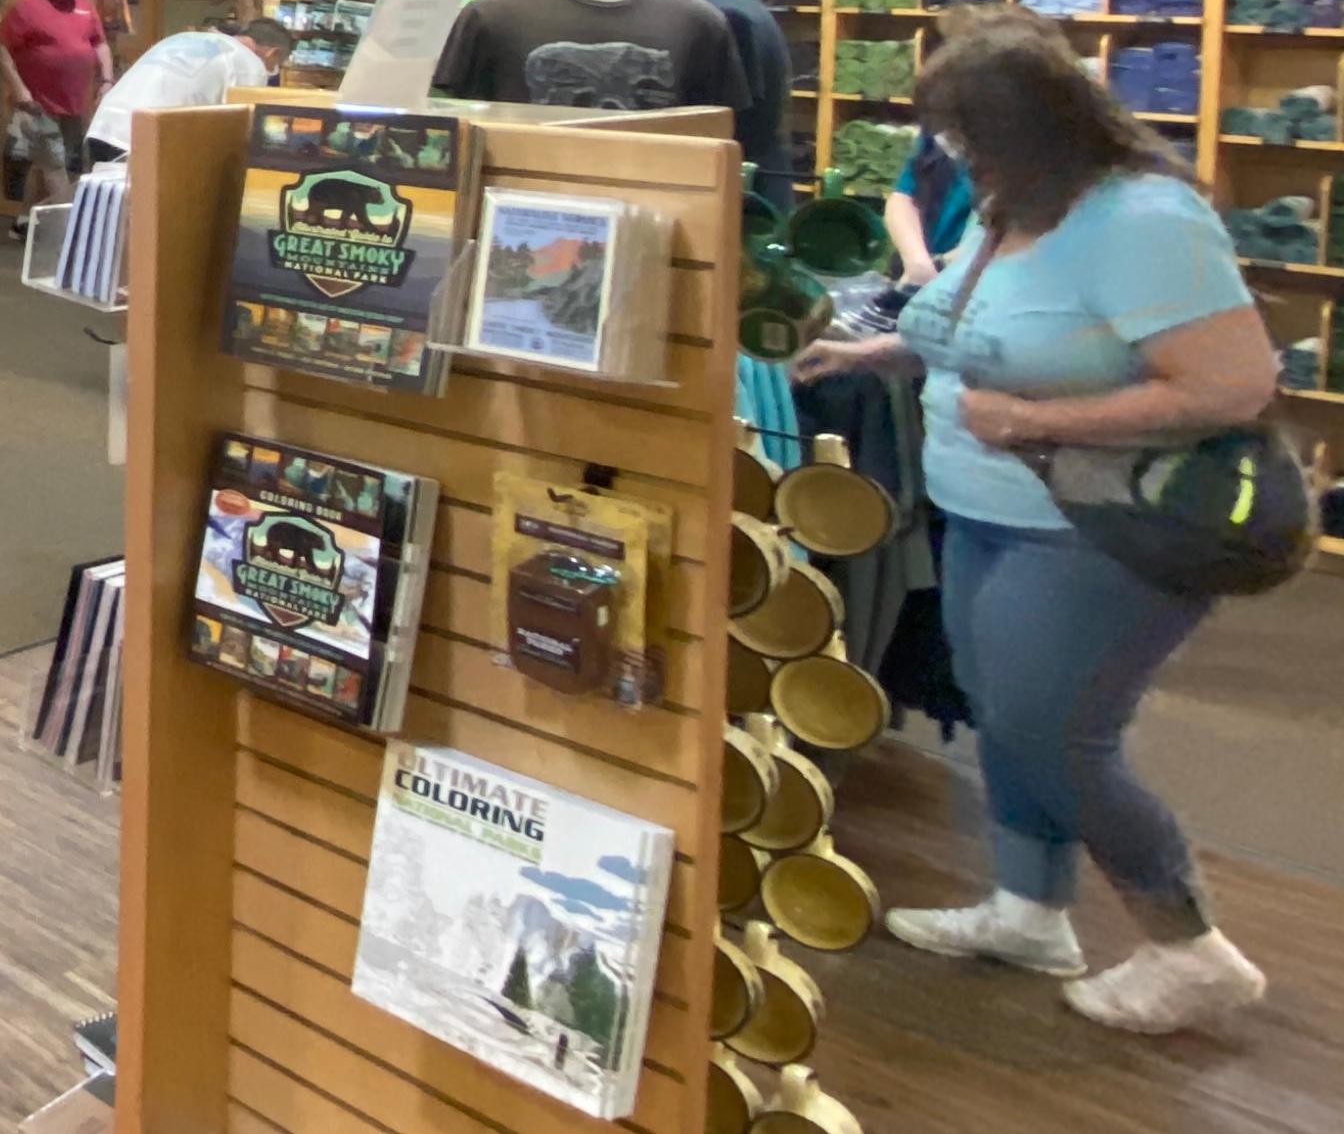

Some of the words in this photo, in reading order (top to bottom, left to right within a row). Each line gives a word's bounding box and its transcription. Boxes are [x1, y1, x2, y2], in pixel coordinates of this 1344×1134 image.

[273, 234, 336, 258] GREAT
[338, 242, 405, 275] SMOKY
[283, 261, 349, 280] NATIONAL
[353, 270, 388, 285] PARK
[259, 490, 312, 513] COLORING
[236, 564, 288, 589] GREAT
[290, 581, 340, 614] SMOKY
[394, 768, 545, 842] COLORING
[397, 751, 549, 818] ULTIMATE
